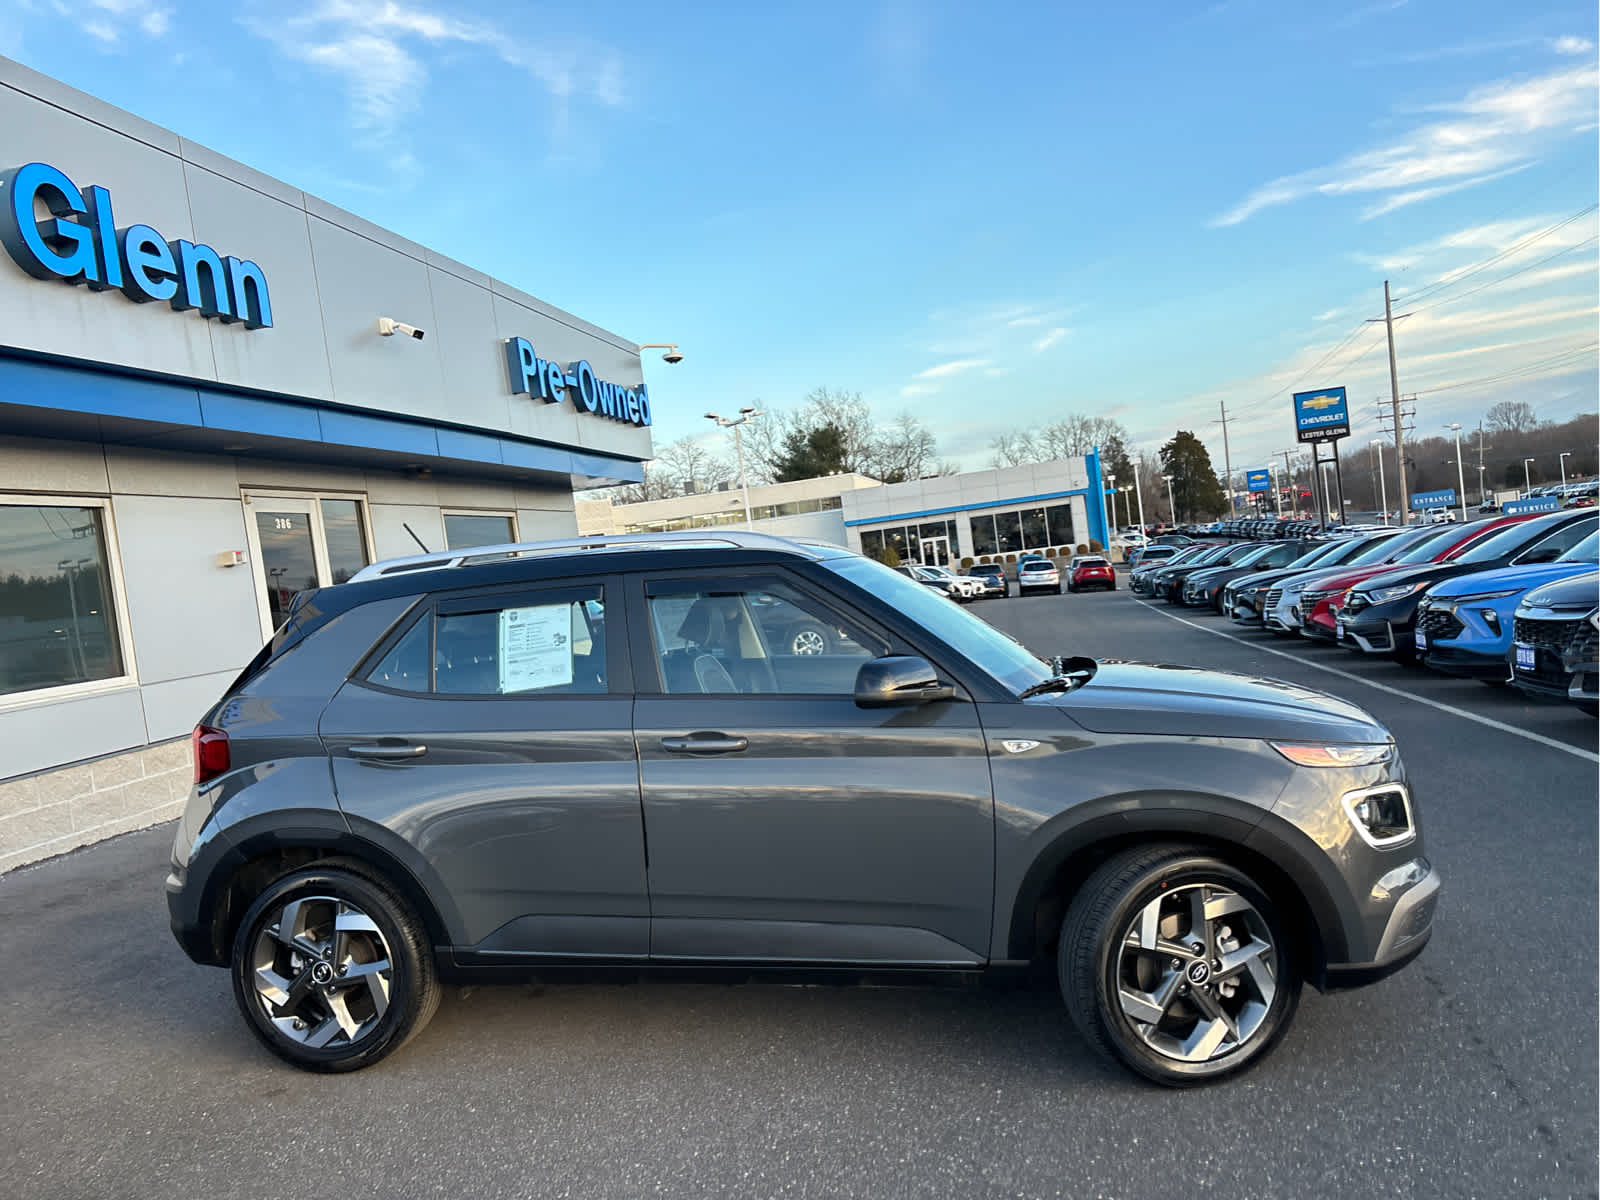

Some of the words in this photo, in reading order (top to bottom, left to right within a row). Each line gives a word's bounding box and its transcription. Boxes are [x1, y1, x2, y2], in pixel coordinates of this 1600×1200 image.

[7, 162, 273, 329] Glenn
[510, 336, 652, 427] Pre-Owned
[1300, 413, 1344, 425] CHEVROLET
[1301, 430, 1325, 439] LESTER
[1325, 428, 1347, 436] GLENN
[1414, 495, 1453, 505] ENTRANCE
[1518, 503, 1556, 513] SERVICE
[274, 518, 292, 529] 386
